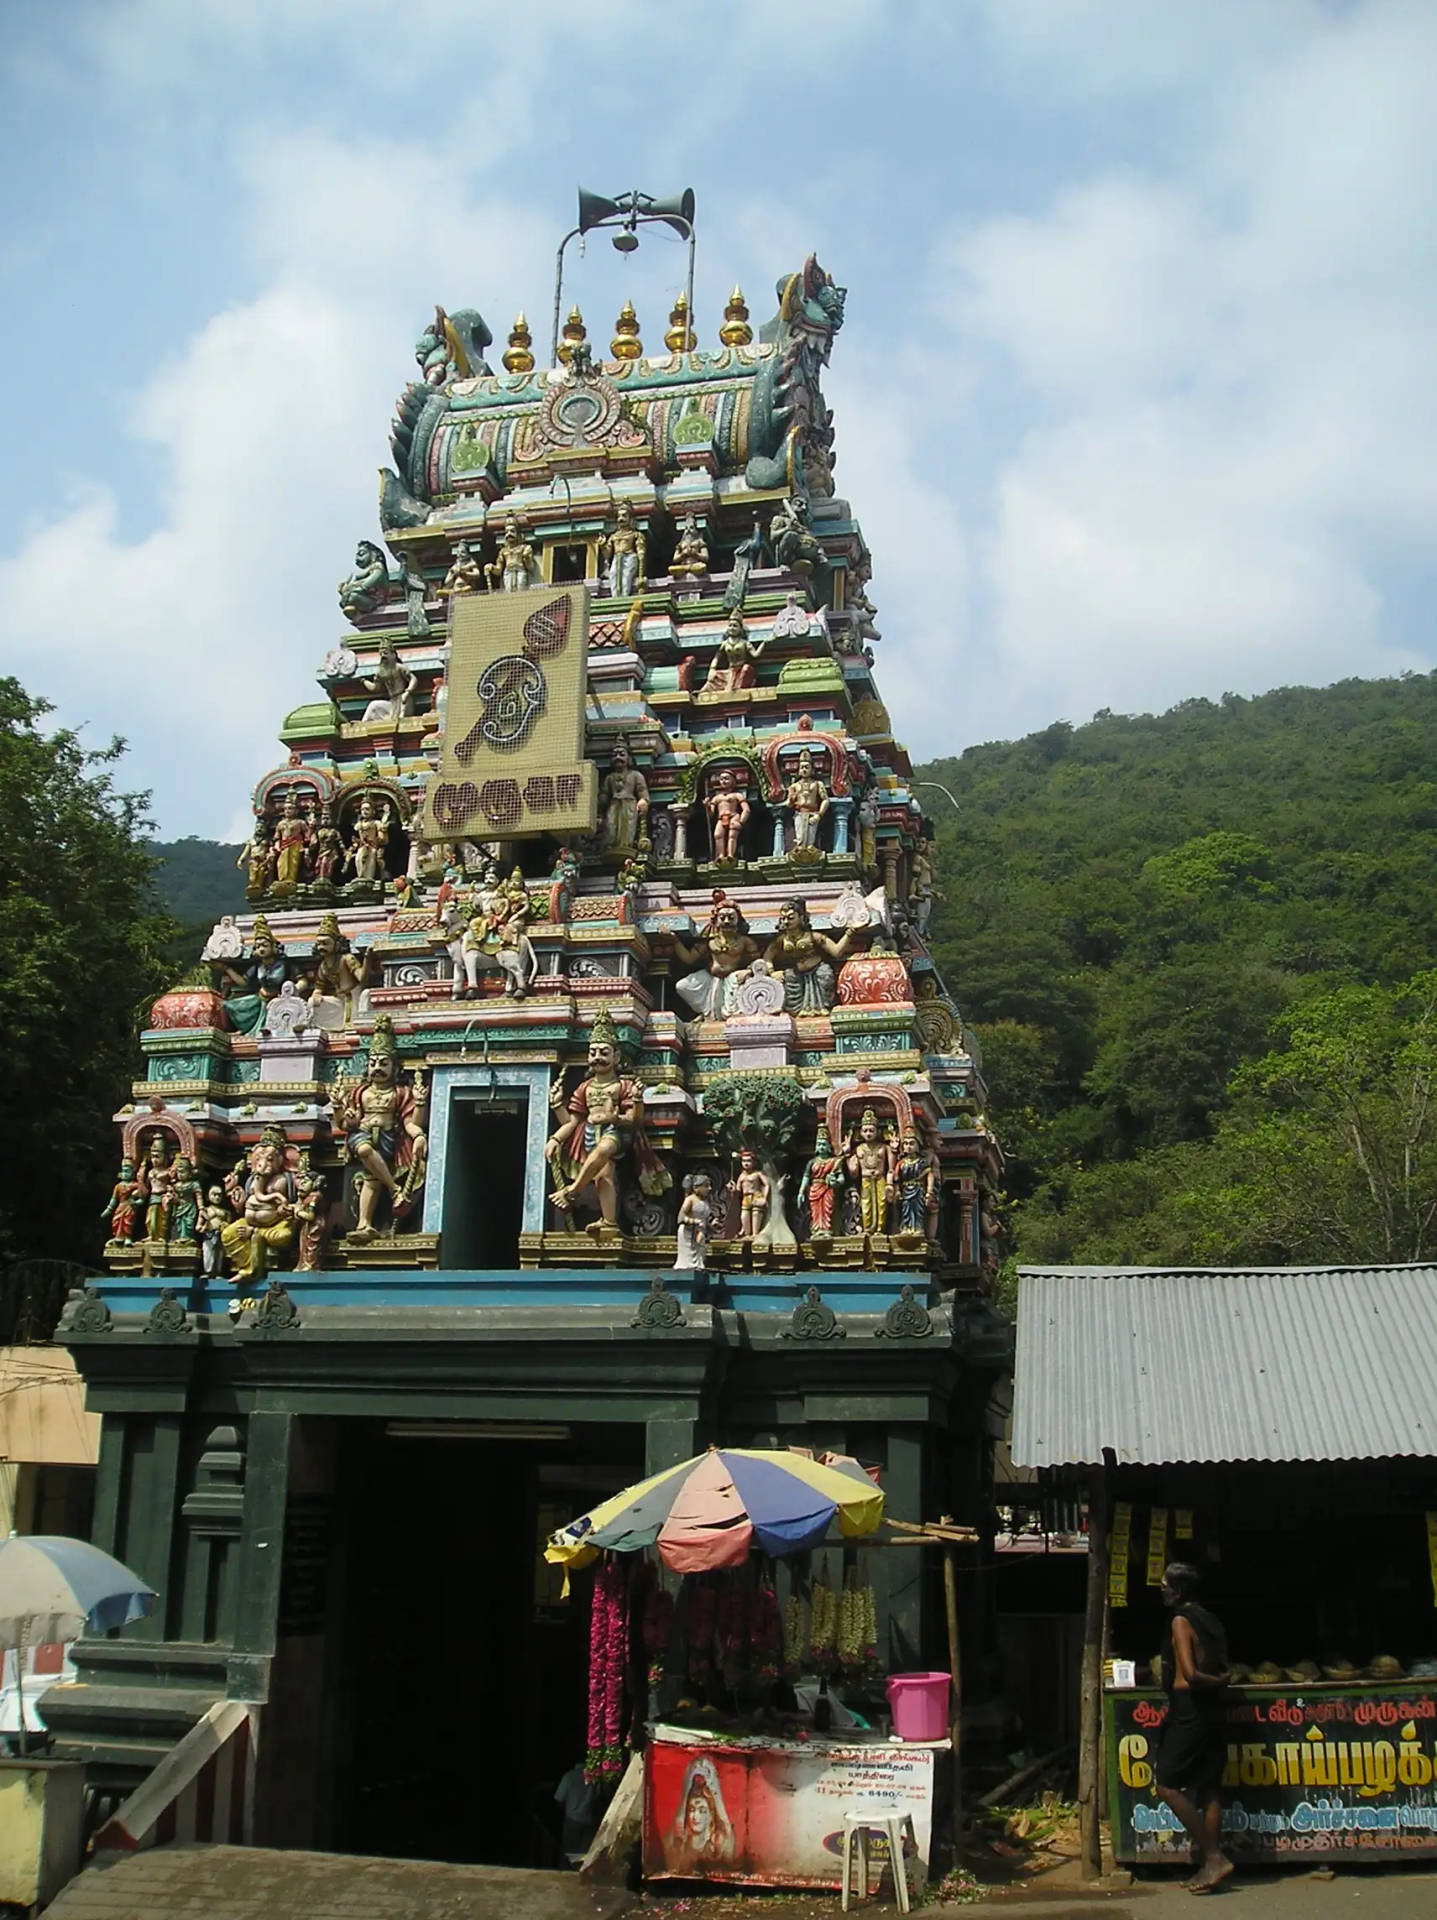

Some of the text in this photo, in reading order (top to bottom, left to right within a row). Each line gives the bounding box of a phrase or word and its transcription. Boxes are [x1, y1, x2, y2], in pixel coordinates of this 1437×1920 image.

[433, 774, 583, 829] முருகா
[1268, 1698, 1304, 1726] வீடு
[1353, 1694, 1436, 1726] முருகன்
[1291, 1798, 1400, 1832] அர்ச்சனை
